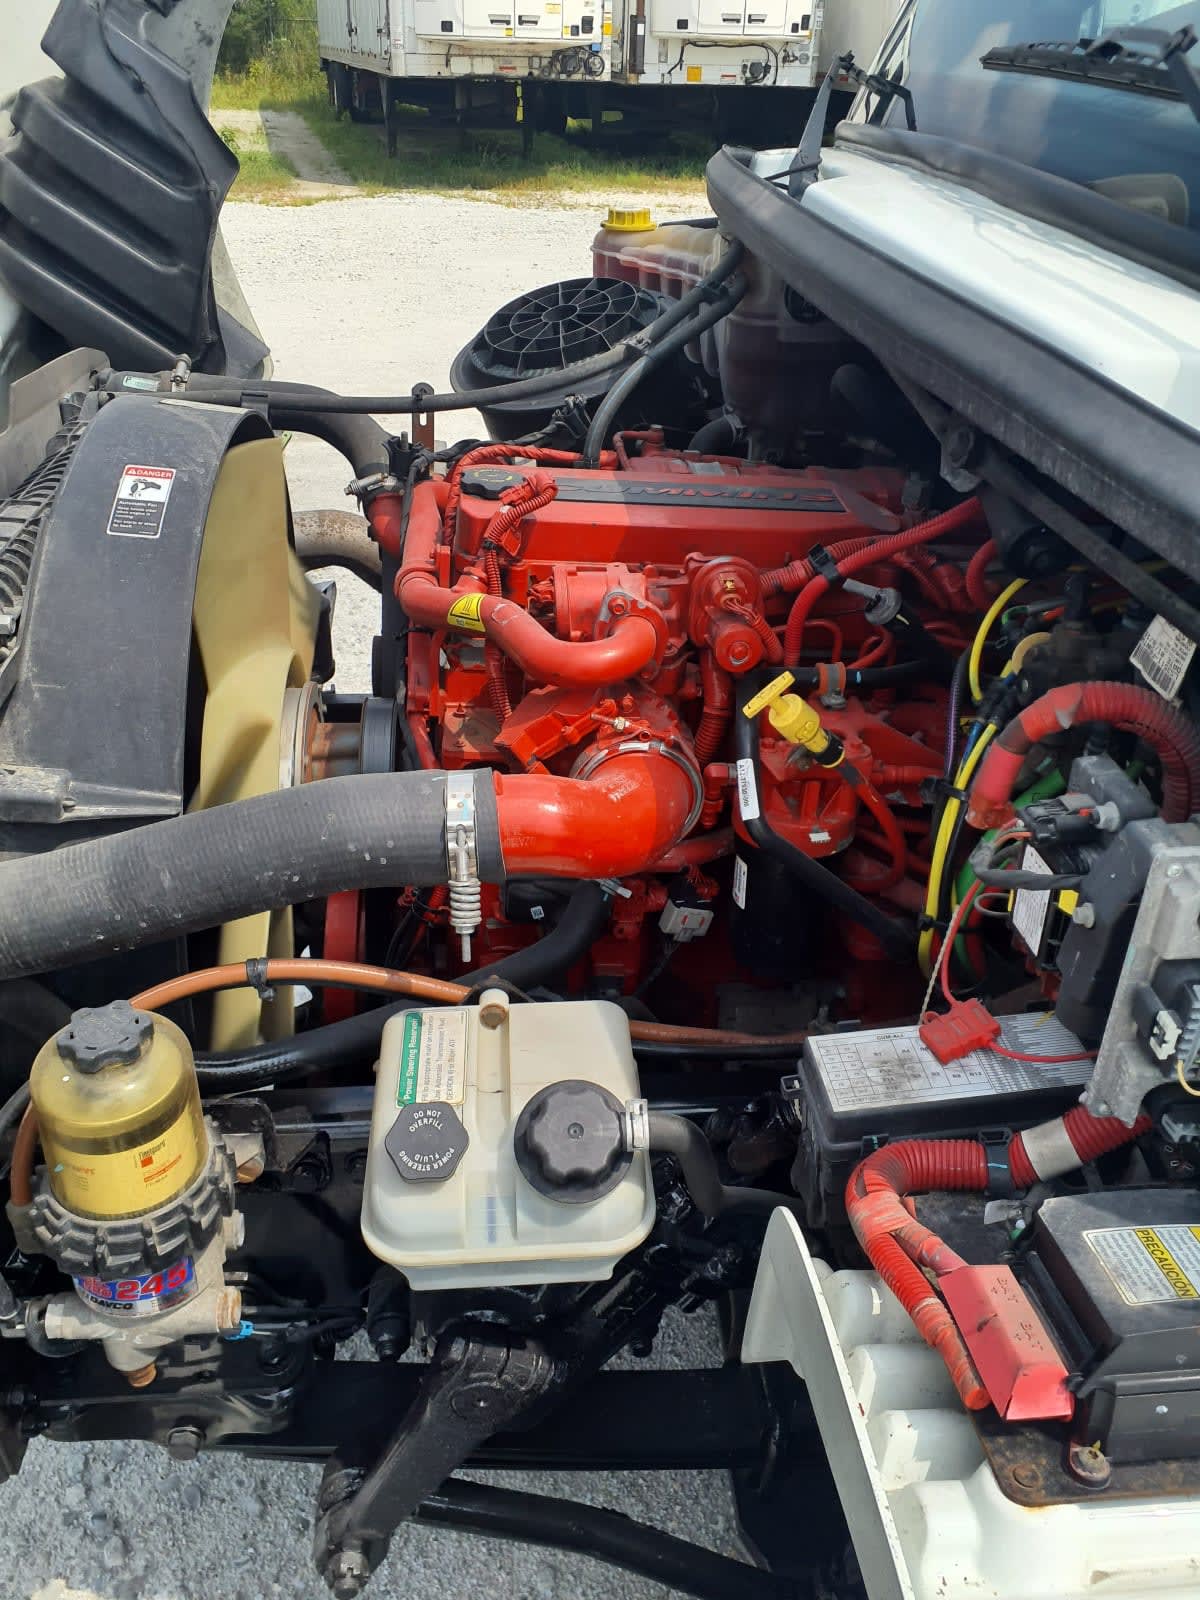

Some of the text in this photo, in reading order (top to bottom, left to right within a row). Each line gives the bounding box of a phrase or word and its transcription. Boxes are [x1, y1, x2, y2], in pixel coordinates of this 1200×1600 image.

[136, 470, 172, 478] DANGER
[403, 1018, 418, 1099] Power Steering Reservoir
[414, 1111, 424, 1119] DO
[409, 1118, 443, 1132] OVERFILL
[399, 1148, 455, 1171] POWER STEERING
[414, 1153, 440, 1162] FLUID
[116, 1262, 188, 1300] 245
[90, 1296, 133, 1309] DAVCO
